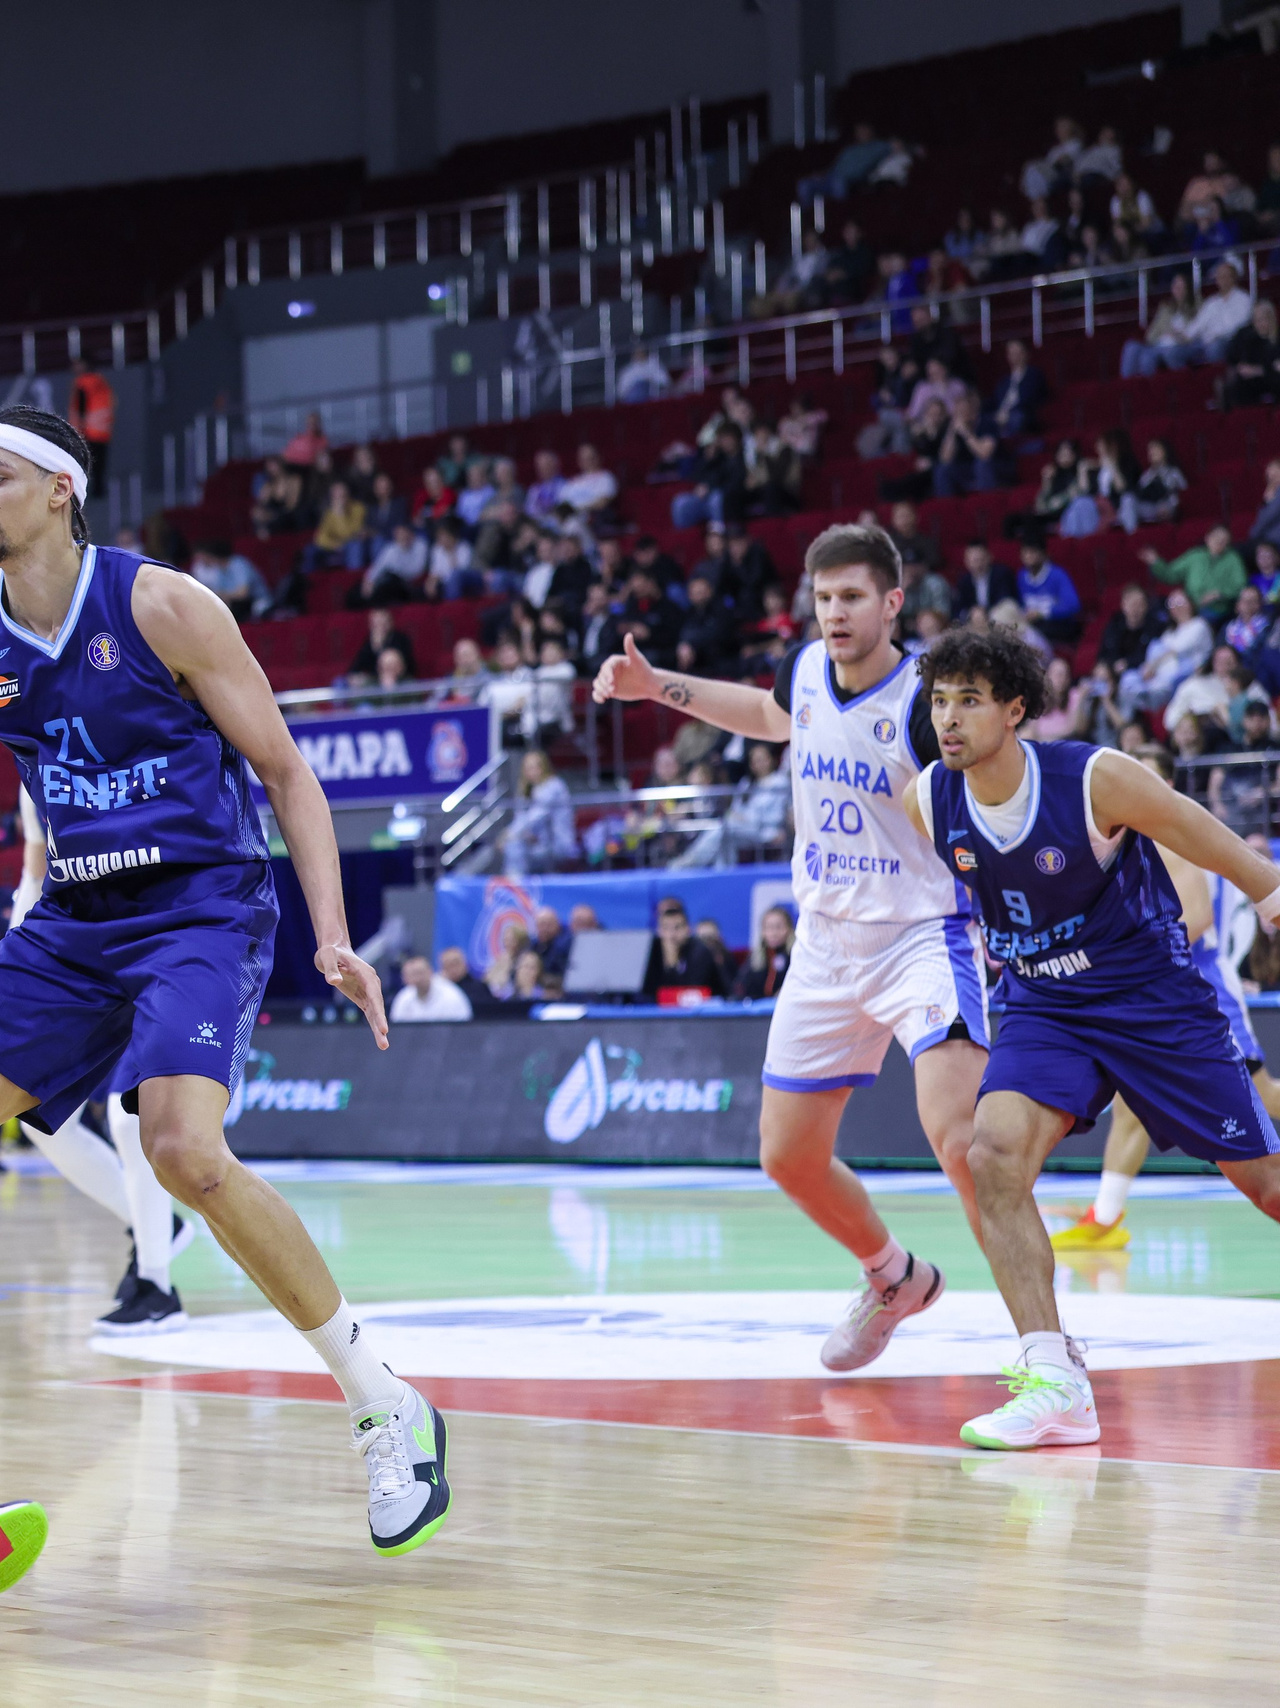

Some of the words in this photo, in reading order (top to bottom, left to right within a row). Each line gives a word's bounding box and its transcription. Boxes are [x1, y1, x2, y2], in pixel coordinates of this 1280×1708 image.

[43, 717, 107, 766] 21
[246, 729, 413, 787] МАРА
[39, 756, 169, 812] ENIT
[798, 751, 894, 798] AMARA
[819, 798, 863, 836] 20
[827, 852, 901, 876] РОССЕТИ
[1002, 889, 1033, 928] 9
[977, 913, 1086, 962] ENIT
[189, 1036, 222, 1049] KELME
